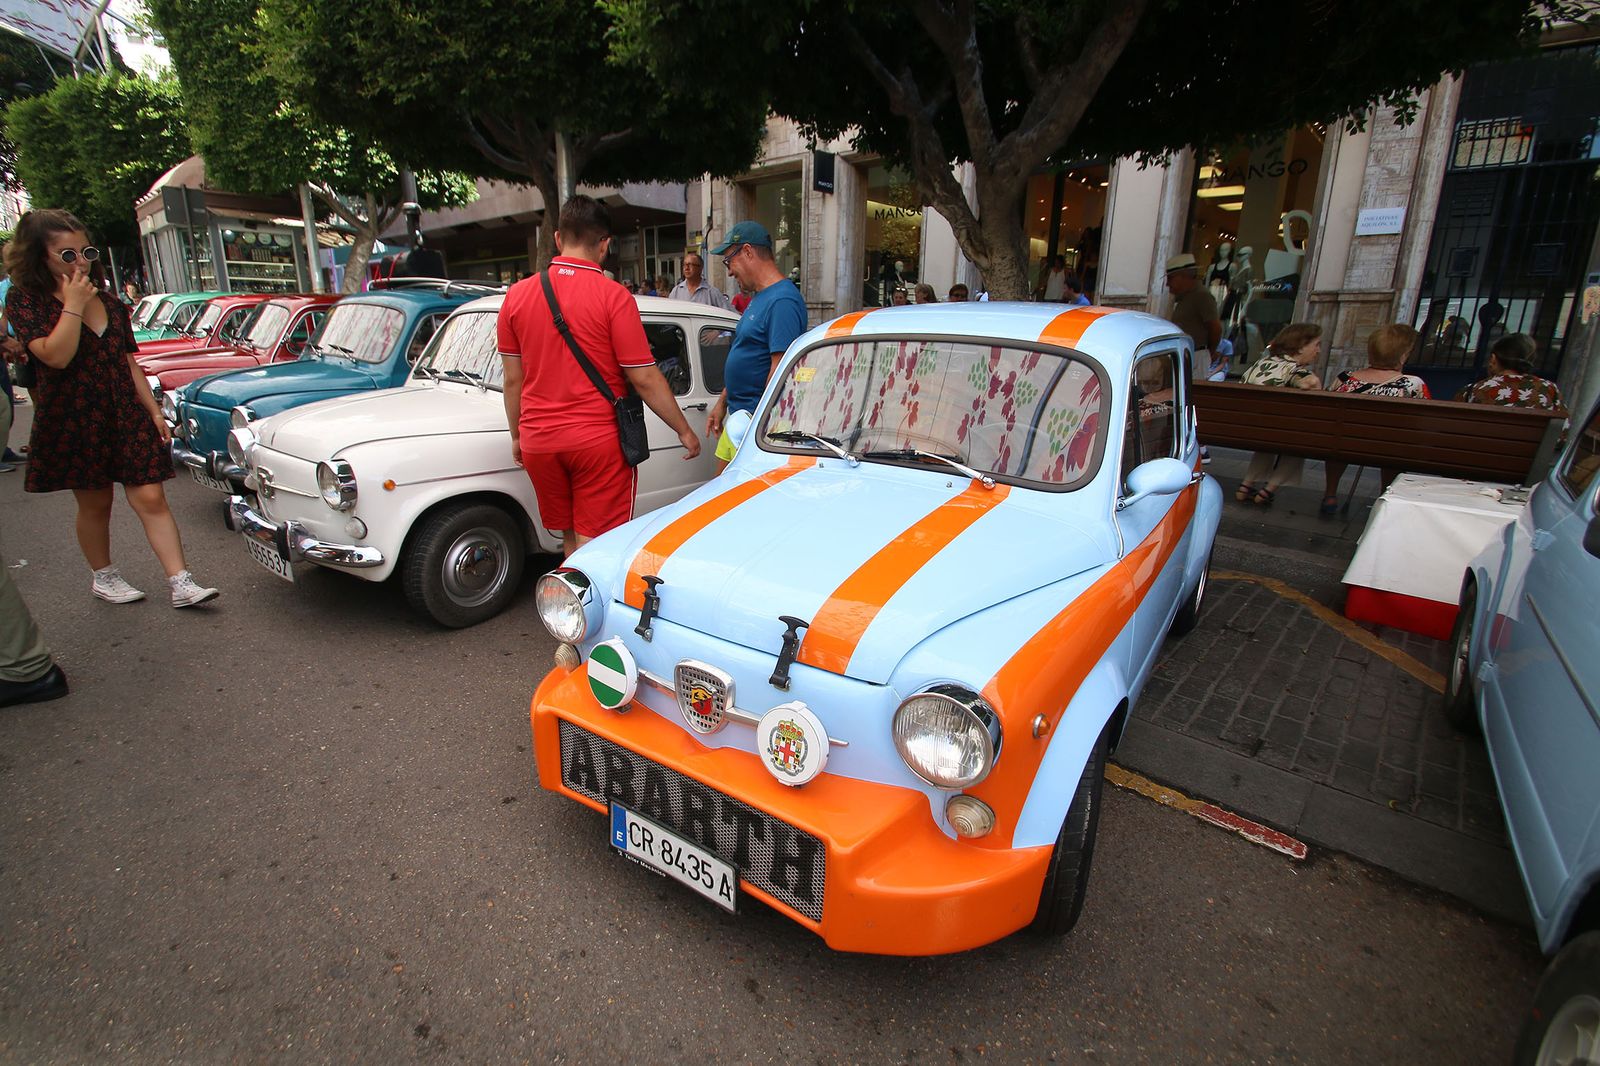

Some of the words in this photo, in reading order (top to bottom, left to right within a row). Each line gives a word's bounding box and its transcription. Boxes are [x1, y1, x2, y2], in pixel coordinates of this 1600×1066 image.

[1210, 159, 1308, 182] MANGO
[568, 732, 819, 902] ABARTH
[616, 831, 624, 842] E
[629, 821, 654, 856] CR
[661, 839, 715, 890] 8435
[719, 872, 732, 902] A
